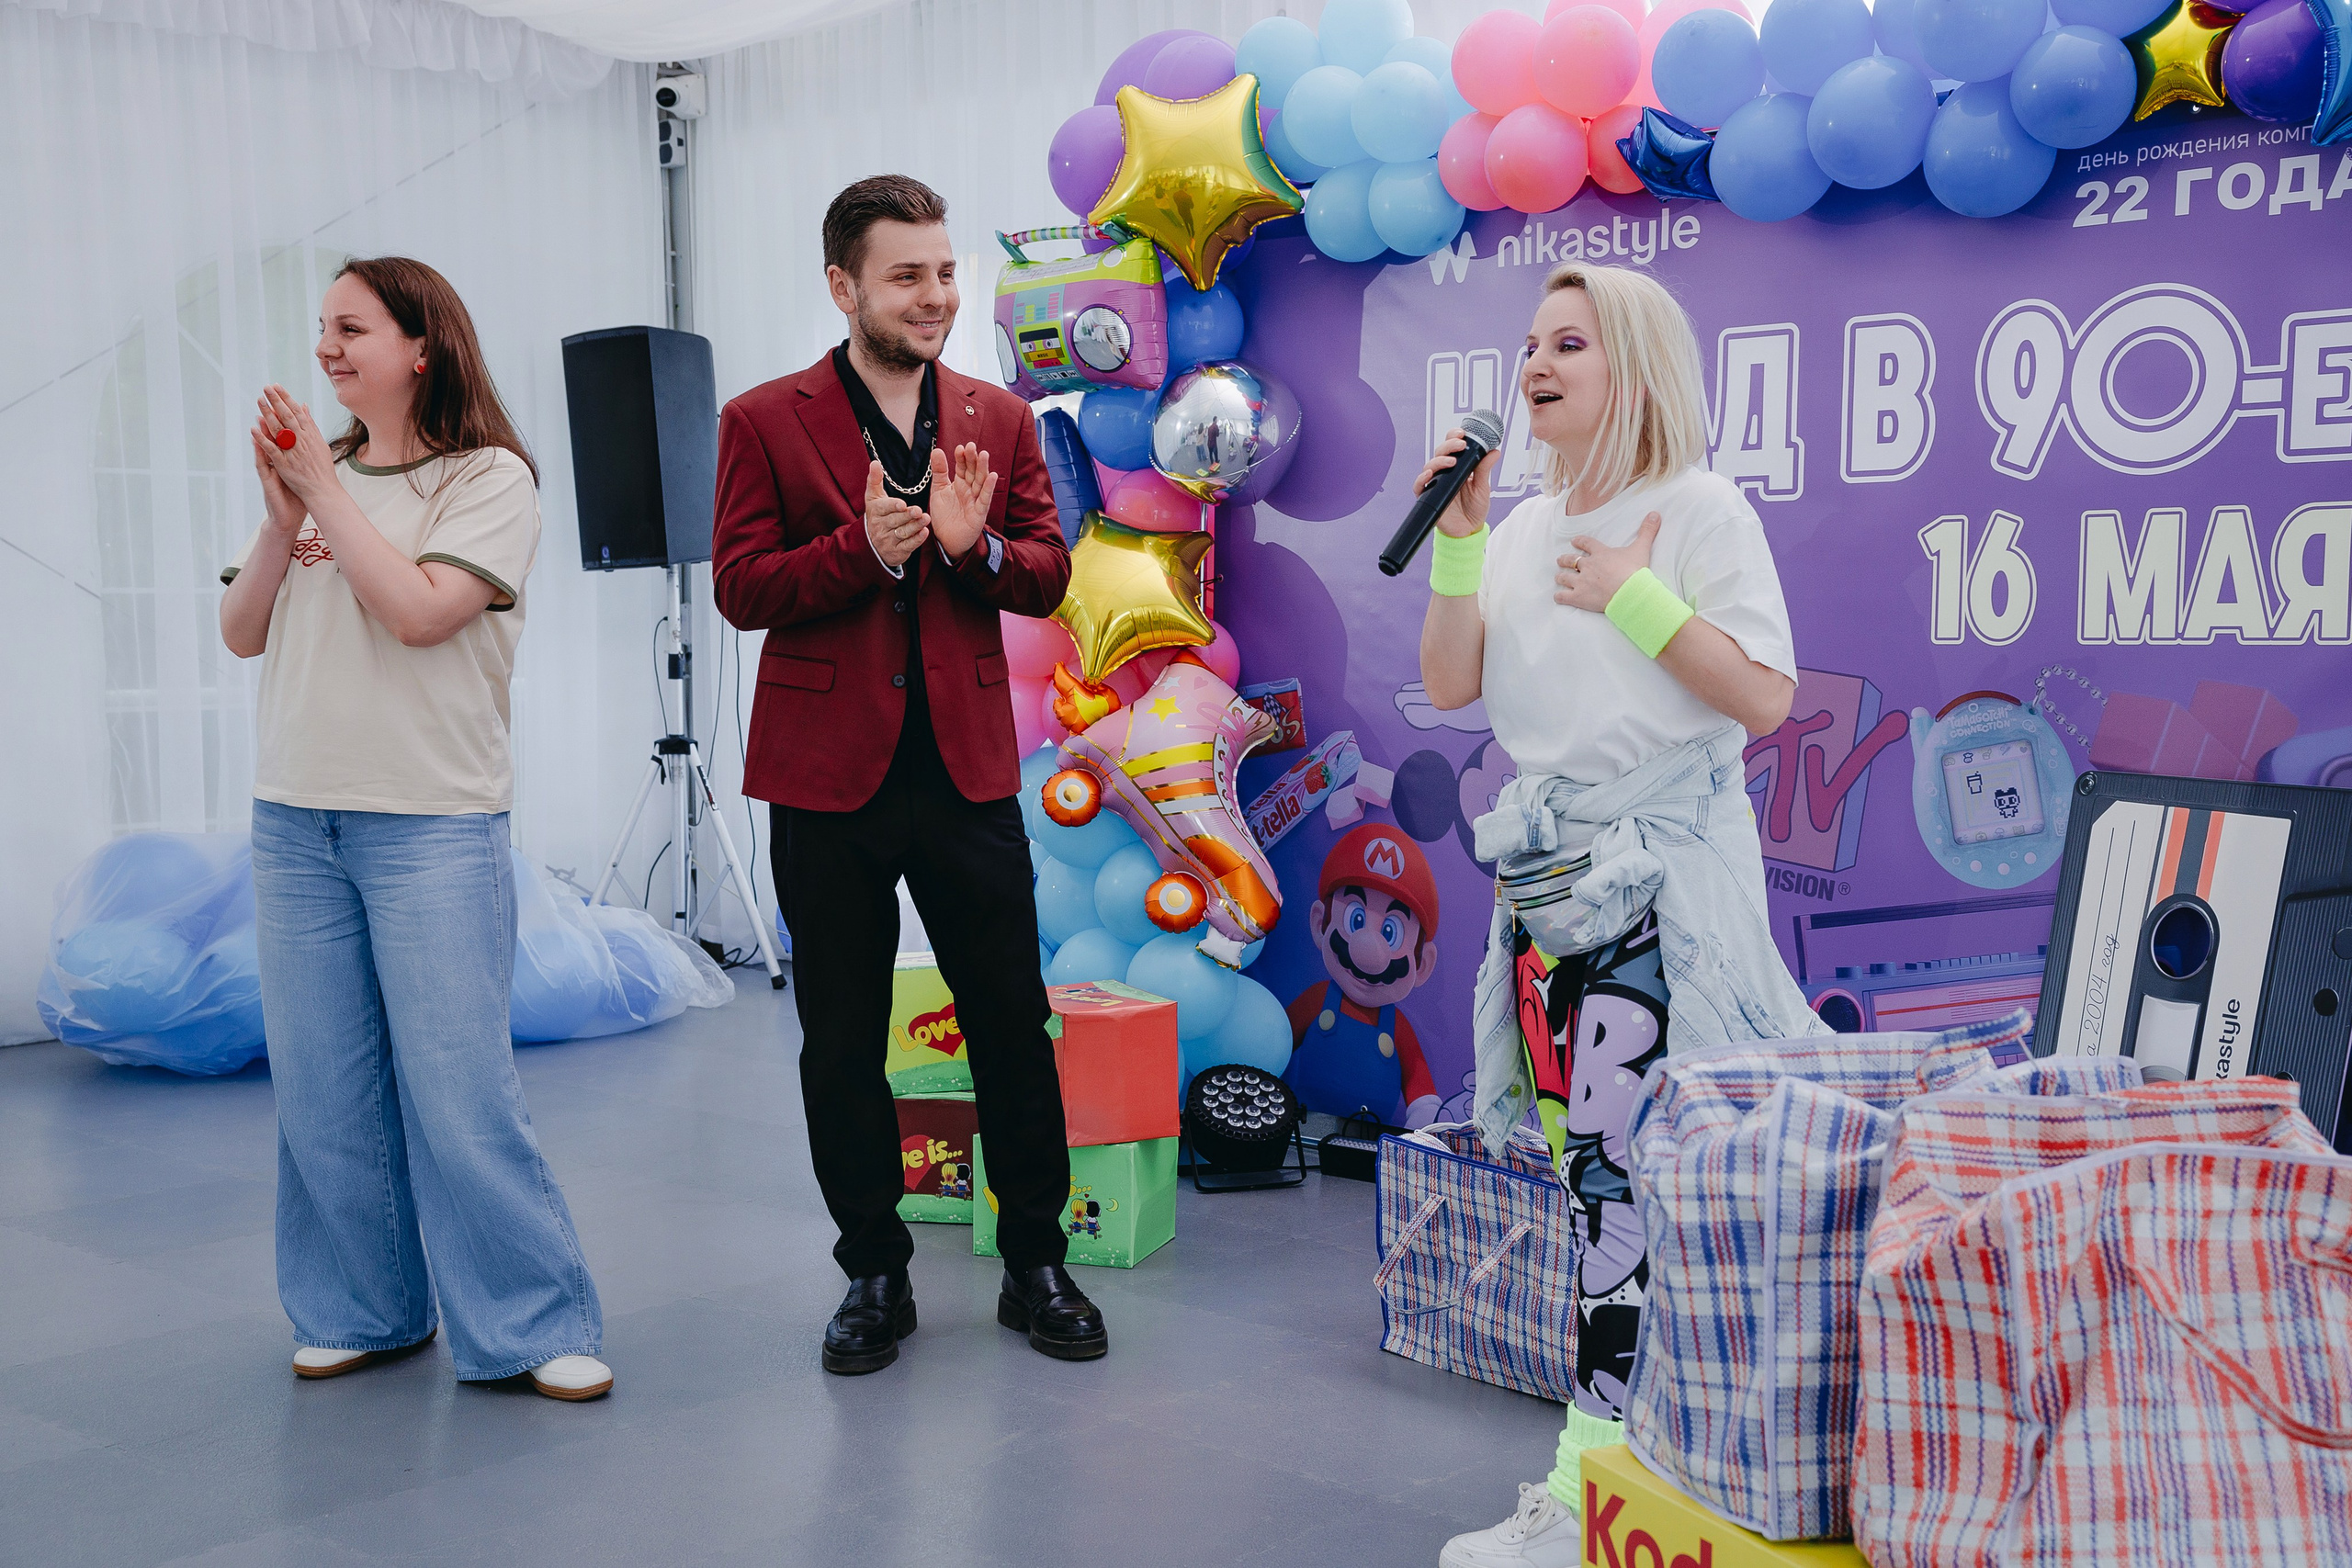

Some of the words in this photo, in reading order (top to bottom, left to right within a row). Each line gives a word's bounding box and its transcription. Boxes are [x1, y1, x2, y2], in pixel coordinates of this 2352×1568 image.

[2076, 150, 2129, 174] день
[2136, 132, 2250, 167] рождения
[2256, 124, 2314, 146] комп
[2072, 175, 2150, 228] 22
[1497, 208, 1702, 268] nikastyle
[1839, 311, 1937, 484] В
[1917, 507, 2038, 646] 16
[1950, 719, 2011, 739] CONNECTION
[1366, 840, 1401, 876] M
[1765, 866, 1836, 902] VISION
[2083, 974, 2108, 1035] 2004
[891, 1015, 962, 1053] Love
